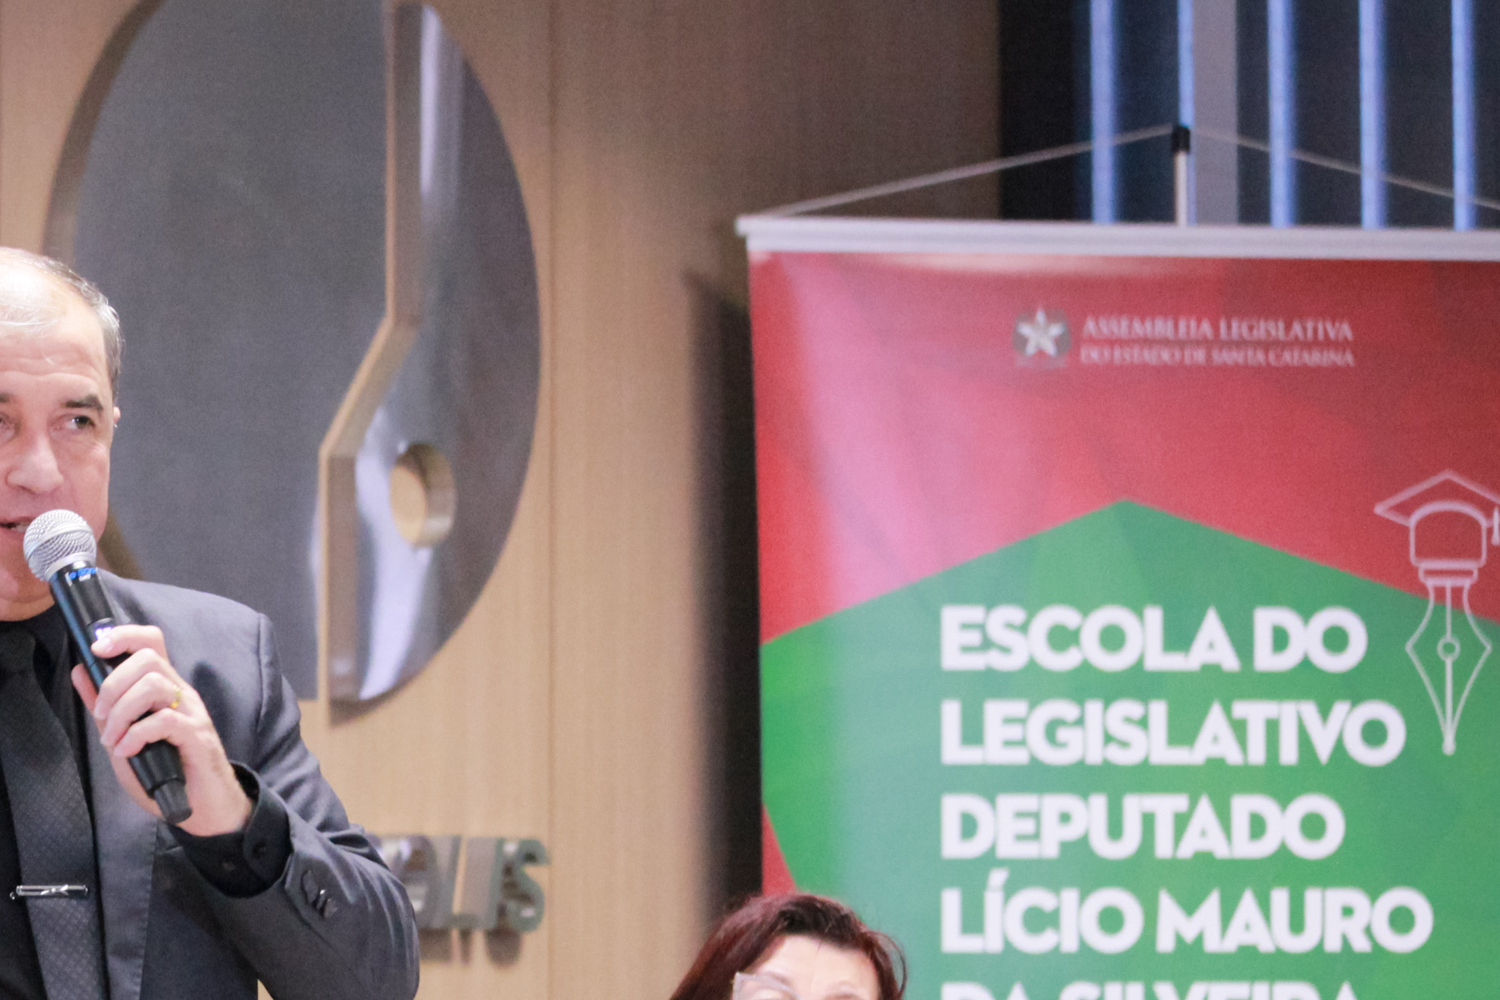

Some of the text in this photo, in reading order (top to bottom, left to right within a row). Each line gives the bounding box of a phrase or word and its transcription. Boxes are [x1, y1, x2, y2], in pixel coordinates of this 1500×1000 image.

[1080, 345, 1354, 367] DO ESTADO DE SANTA CATARINA
[1083, 316, 1353, 342] ASSEMBLEIA LEGISLATIVA
[941, 606, 1368, 672] ESCOLA DO
[941, 699, 1406, 766] LEGISLATIVO
[941, 793, 1345, 860] DEPUTADO
[941, 867, 1434, 954] LÍCIO MAURO
